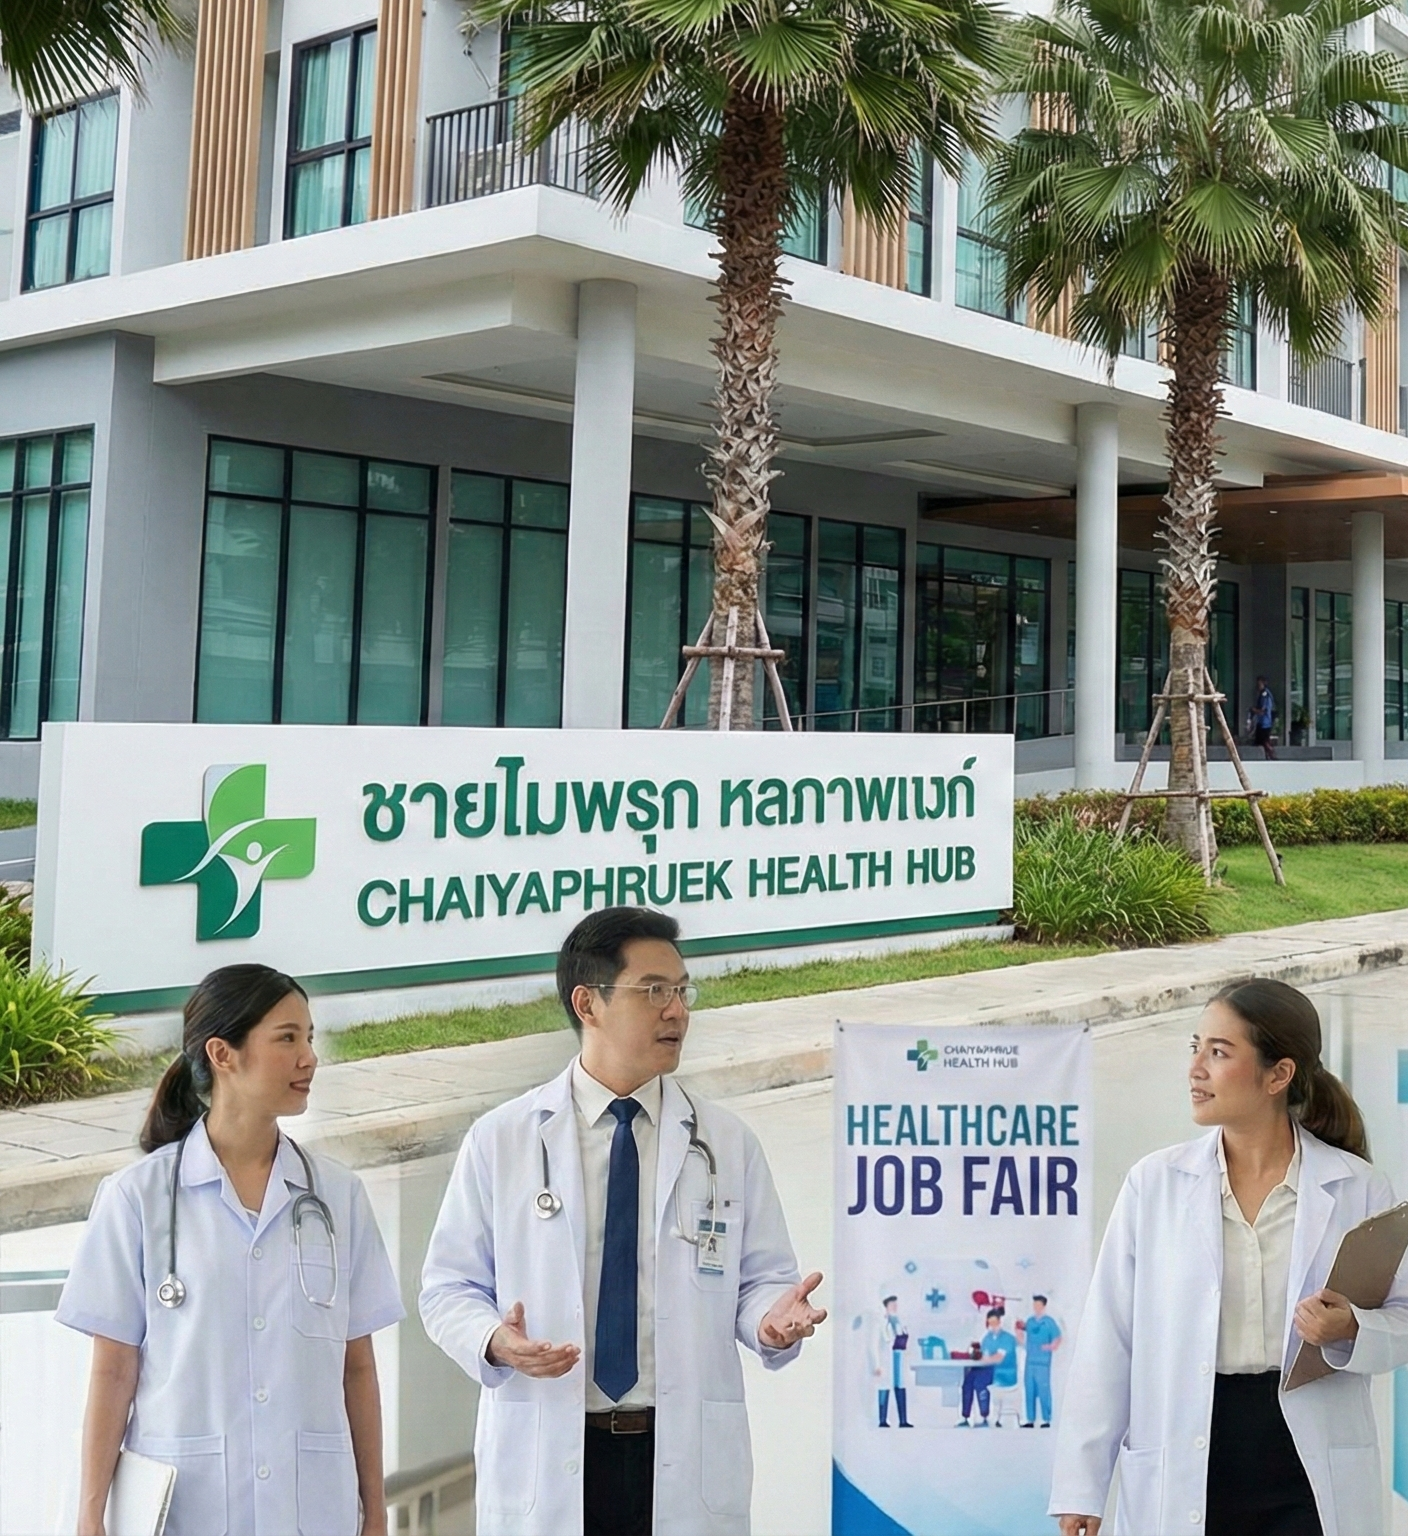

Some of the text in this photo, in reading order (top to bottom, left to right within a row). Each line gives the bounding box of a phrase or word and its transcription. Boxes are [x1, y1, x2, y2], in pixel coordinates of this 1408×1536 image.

[357, 845, 976, 928] CHAIYAPHRUEK HEALTH HUB
[943, 1057, 1019, 1069] HEALTH HUB
[846, 1104, 1080, 1147] HEALTHCARE
[847, 1154, 1079, 1217] JOB FAIR
